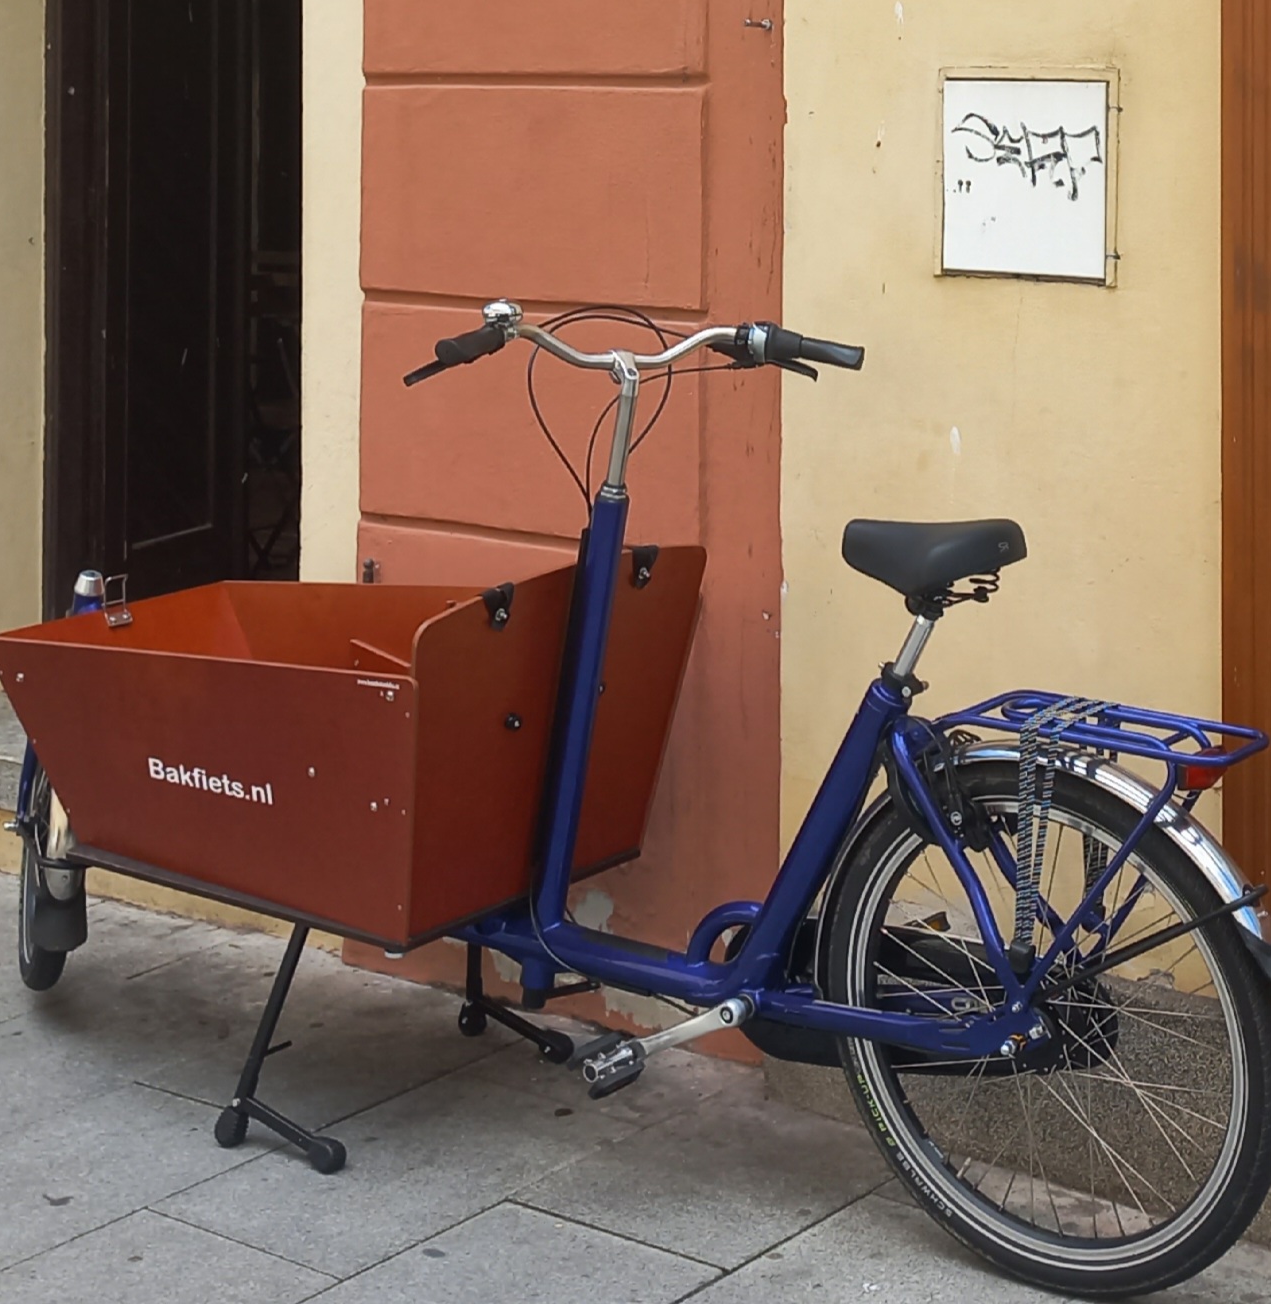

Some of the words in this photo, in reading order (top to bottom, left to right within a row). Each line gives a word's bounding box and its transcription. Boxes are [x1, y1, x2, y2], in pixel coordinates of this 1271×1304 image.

[148, 756, 273, 806] Bakfiets.nl
[857, 1074, 888, 1132] PICK-UP
[896, 1151, 954, 1218] SCHWALBE
